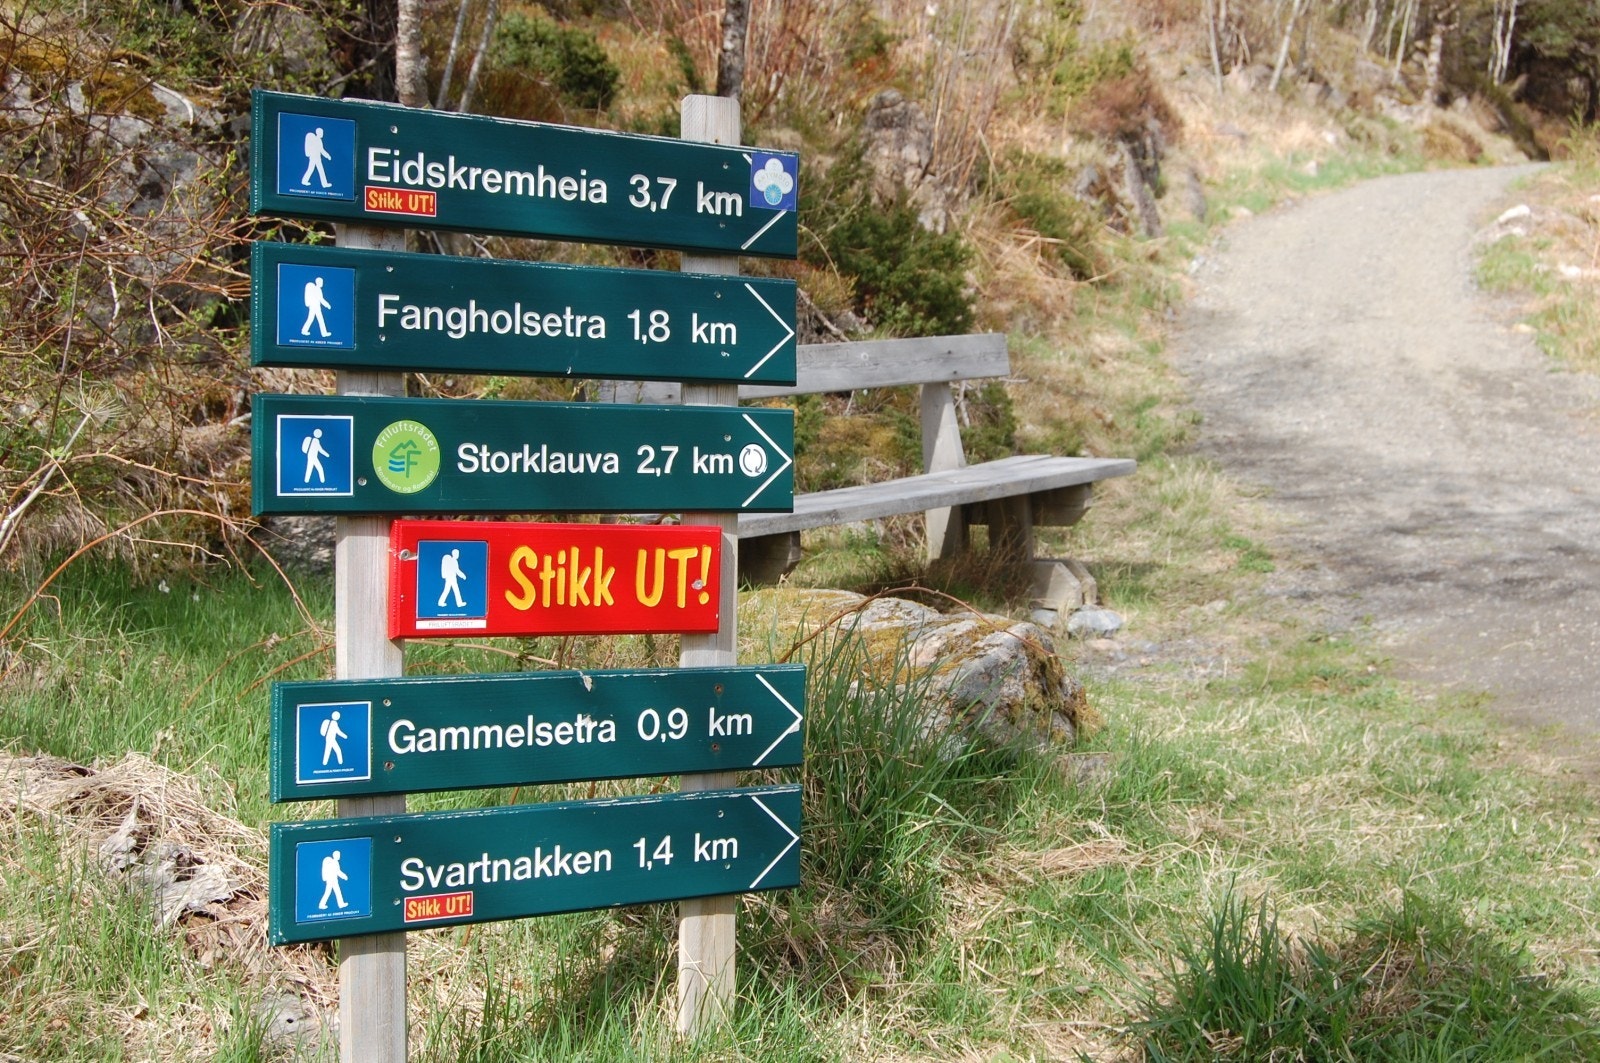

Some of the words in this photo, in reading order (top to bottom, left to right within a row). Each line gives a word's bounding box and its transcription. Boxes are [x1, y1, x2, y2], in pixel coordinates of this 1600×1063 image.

[366, 147, 608, 204] Eidskremheia
[628, 173, 677, 213] 3,7
[696, 181, 743, 217] km
[368, 190, 402, 209] Stikk
[409, 194, 434, 213] UT!
[378, 294, 606, 339] Fangholsetra
[627, 309, 671, 345] 1,8
[691, 312, 737, 345] km
[457, 442, 620, 474] Storklauva
[636, 444, 679, 477] 2,7
[692, 446, 734, 474] km
[505, 545, 616, 611] Stikk
[635, 544, 712, 609] UT!
[388, 713, 616, 755] Gammelsetra
[637, 707, 689, 743] 0,9
[708, 707, 753, 737] km
[399, 844, 612, 892] Svartnakken
[633, 835, 674, 871] 1,4
[694, 832, 738, 863] km
[406, 898, 441, 919] Stikk
[445, 894, 471, 914] UT!
